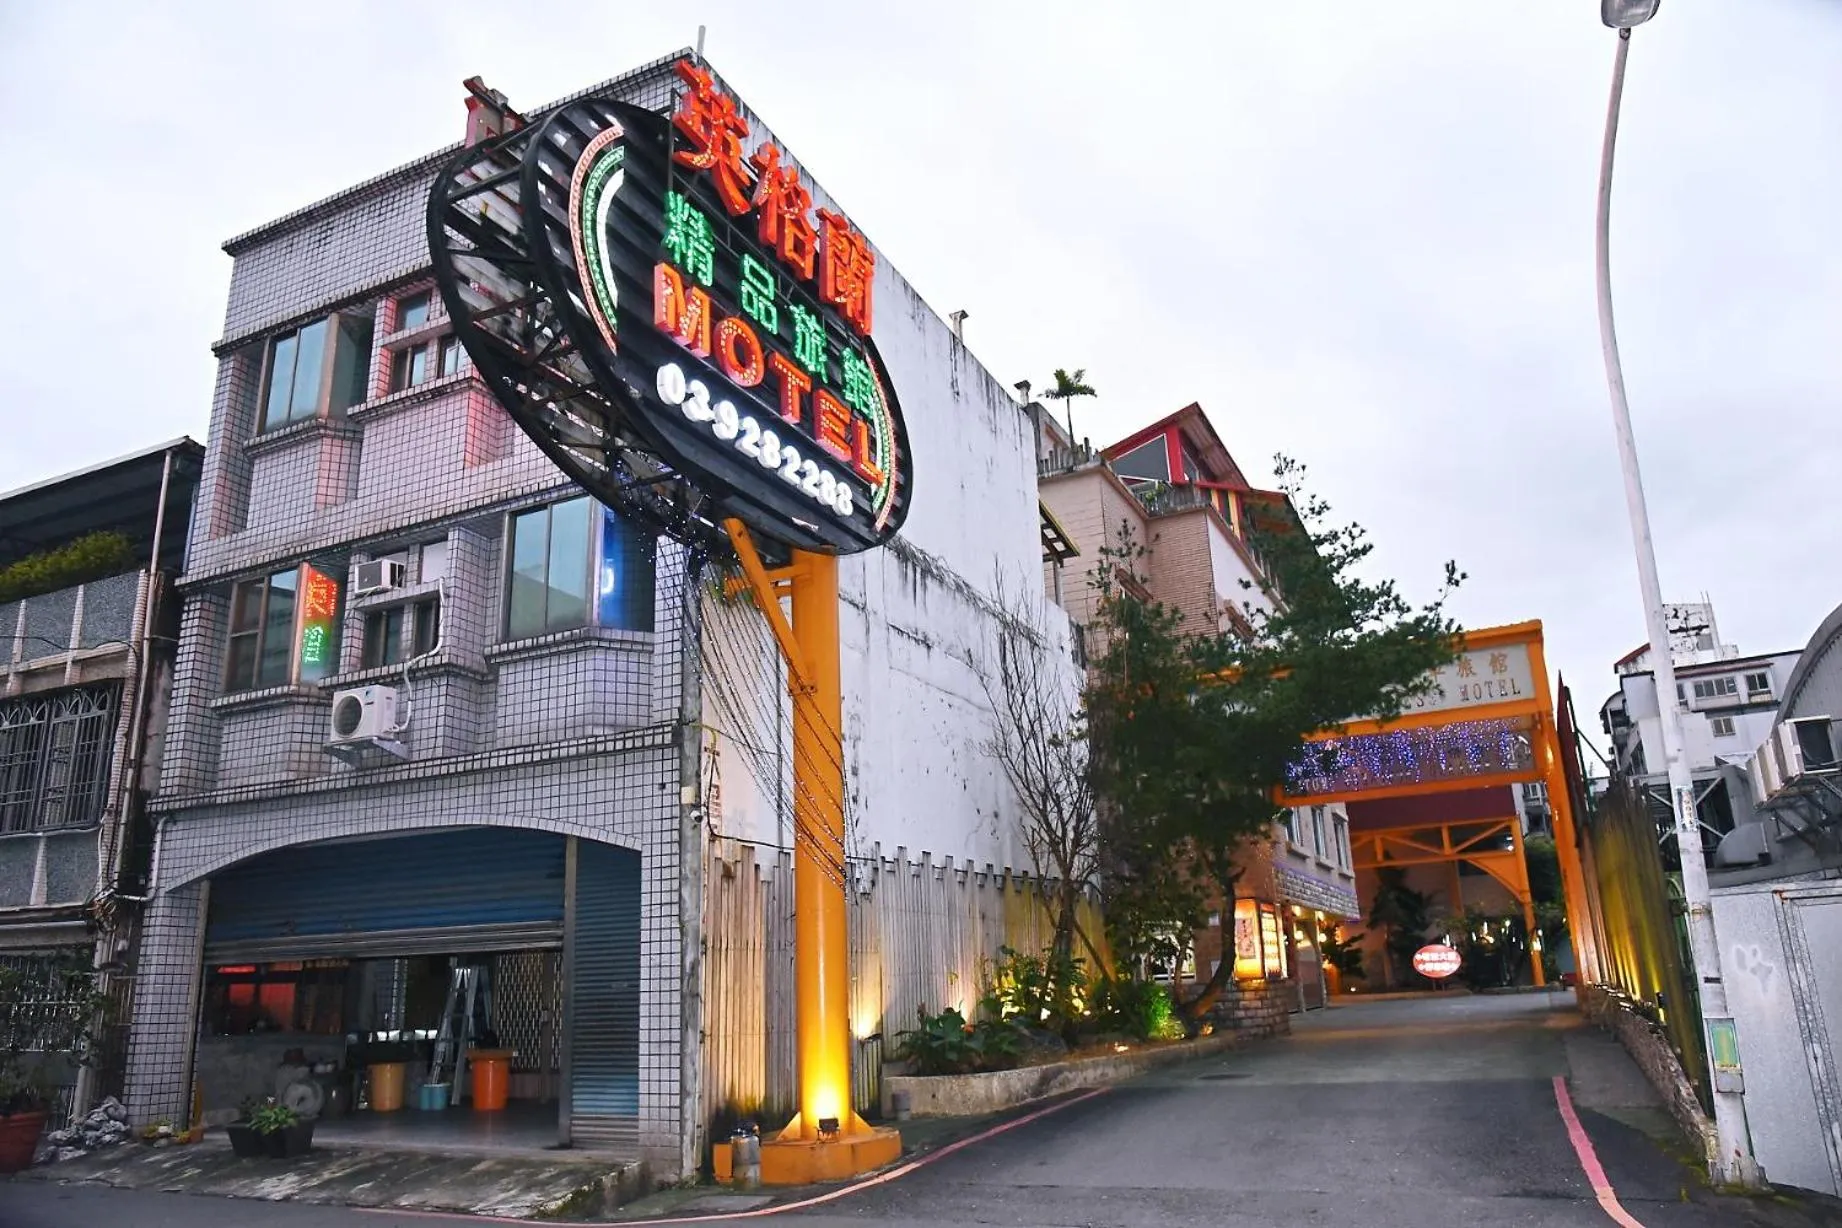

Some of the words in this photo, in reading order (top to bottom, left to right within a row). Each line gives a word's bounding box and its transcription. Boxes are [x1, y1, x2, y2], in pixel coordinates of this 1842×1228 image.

[661, 190, 875, 421] 精品旅館
[671, 58, 875, 336] 英格蘭
[653, 262, 885, 486] MOTEL
[1459, 678, 1522, 702] MOTEL
